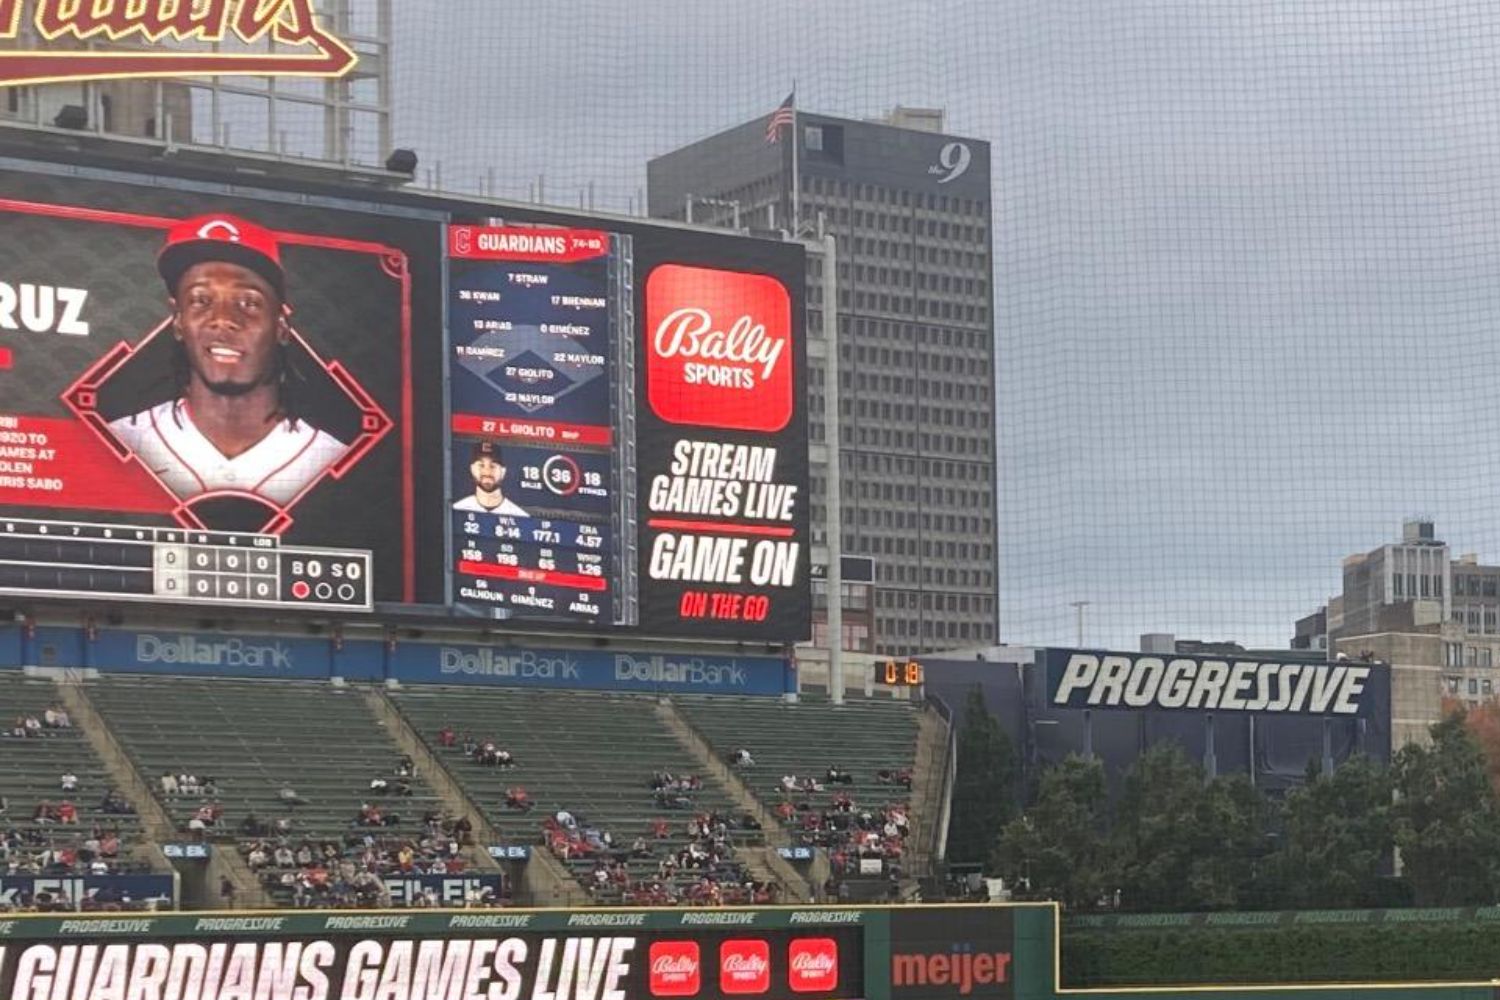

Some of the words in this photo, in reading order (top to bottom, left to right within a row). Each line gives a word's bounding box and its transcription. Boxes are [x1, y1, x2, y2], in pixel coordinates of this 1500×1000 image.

[478, 234, 566, 254] GUARDIANS
[654, 307, 786, 381] Bally
[684, 362, 755, 389] SPORTS
[482, 421, 495, 432] 27
[511, 424, 555, 438] GIOLITO
[29, 433, 48, 446] TO
[39, 449, 56, 460] AT
[671, 440, 777, 482] STREAM
[27, 478, 63, 491] SABO
[522, 466, 540, 480] 18
[584, 472, 601, 486] 18
[648, 475, 741, 517] GAMES
[744, 483, 798, 521] LIVE
[464, 522, 479, 534] 32
[197, 553, 208, 567] 0
[227, 555, 238, 568] 0
[257, 556, 268, 570] 0
[649, 533, 748, 585] GAME
[750, 540, 799, 587] ON
[292, 561, 303, 575] B
[307, 560, 321, 577] 0
[331, 563, 343, 577] S
[347, 562, 361, 580] 0
[197, 579, 208, 593] 0
[227, 581, 238, 594] 0
[681, 591, 707, 618] ON
[710, 592, 741, 620] THE
[744, 595, 769, 621] GO
[1054, 653, 1371, 713] PROGRESSIVE
[196, 917, 282, 931] PROGRESSIVE
[325, 916, 409, 929] PROGRESSIVE
[450, 915, 530, 927] PROGRESSIVE
[568, 914, 645, 926] PROGRESSIVE
[681, 912, 755, 924] PROGRESSIVE
[790, 911, 861, 923] PROGRESSIVE
[60, 920, 150, 933] PROGRESSIVE
[652, 955, 697, 974] Bally
[723, 954, 766, 973] Bally
[792, 952, 835, 971] Bally
[893, 942, 1011, 994] meijer
